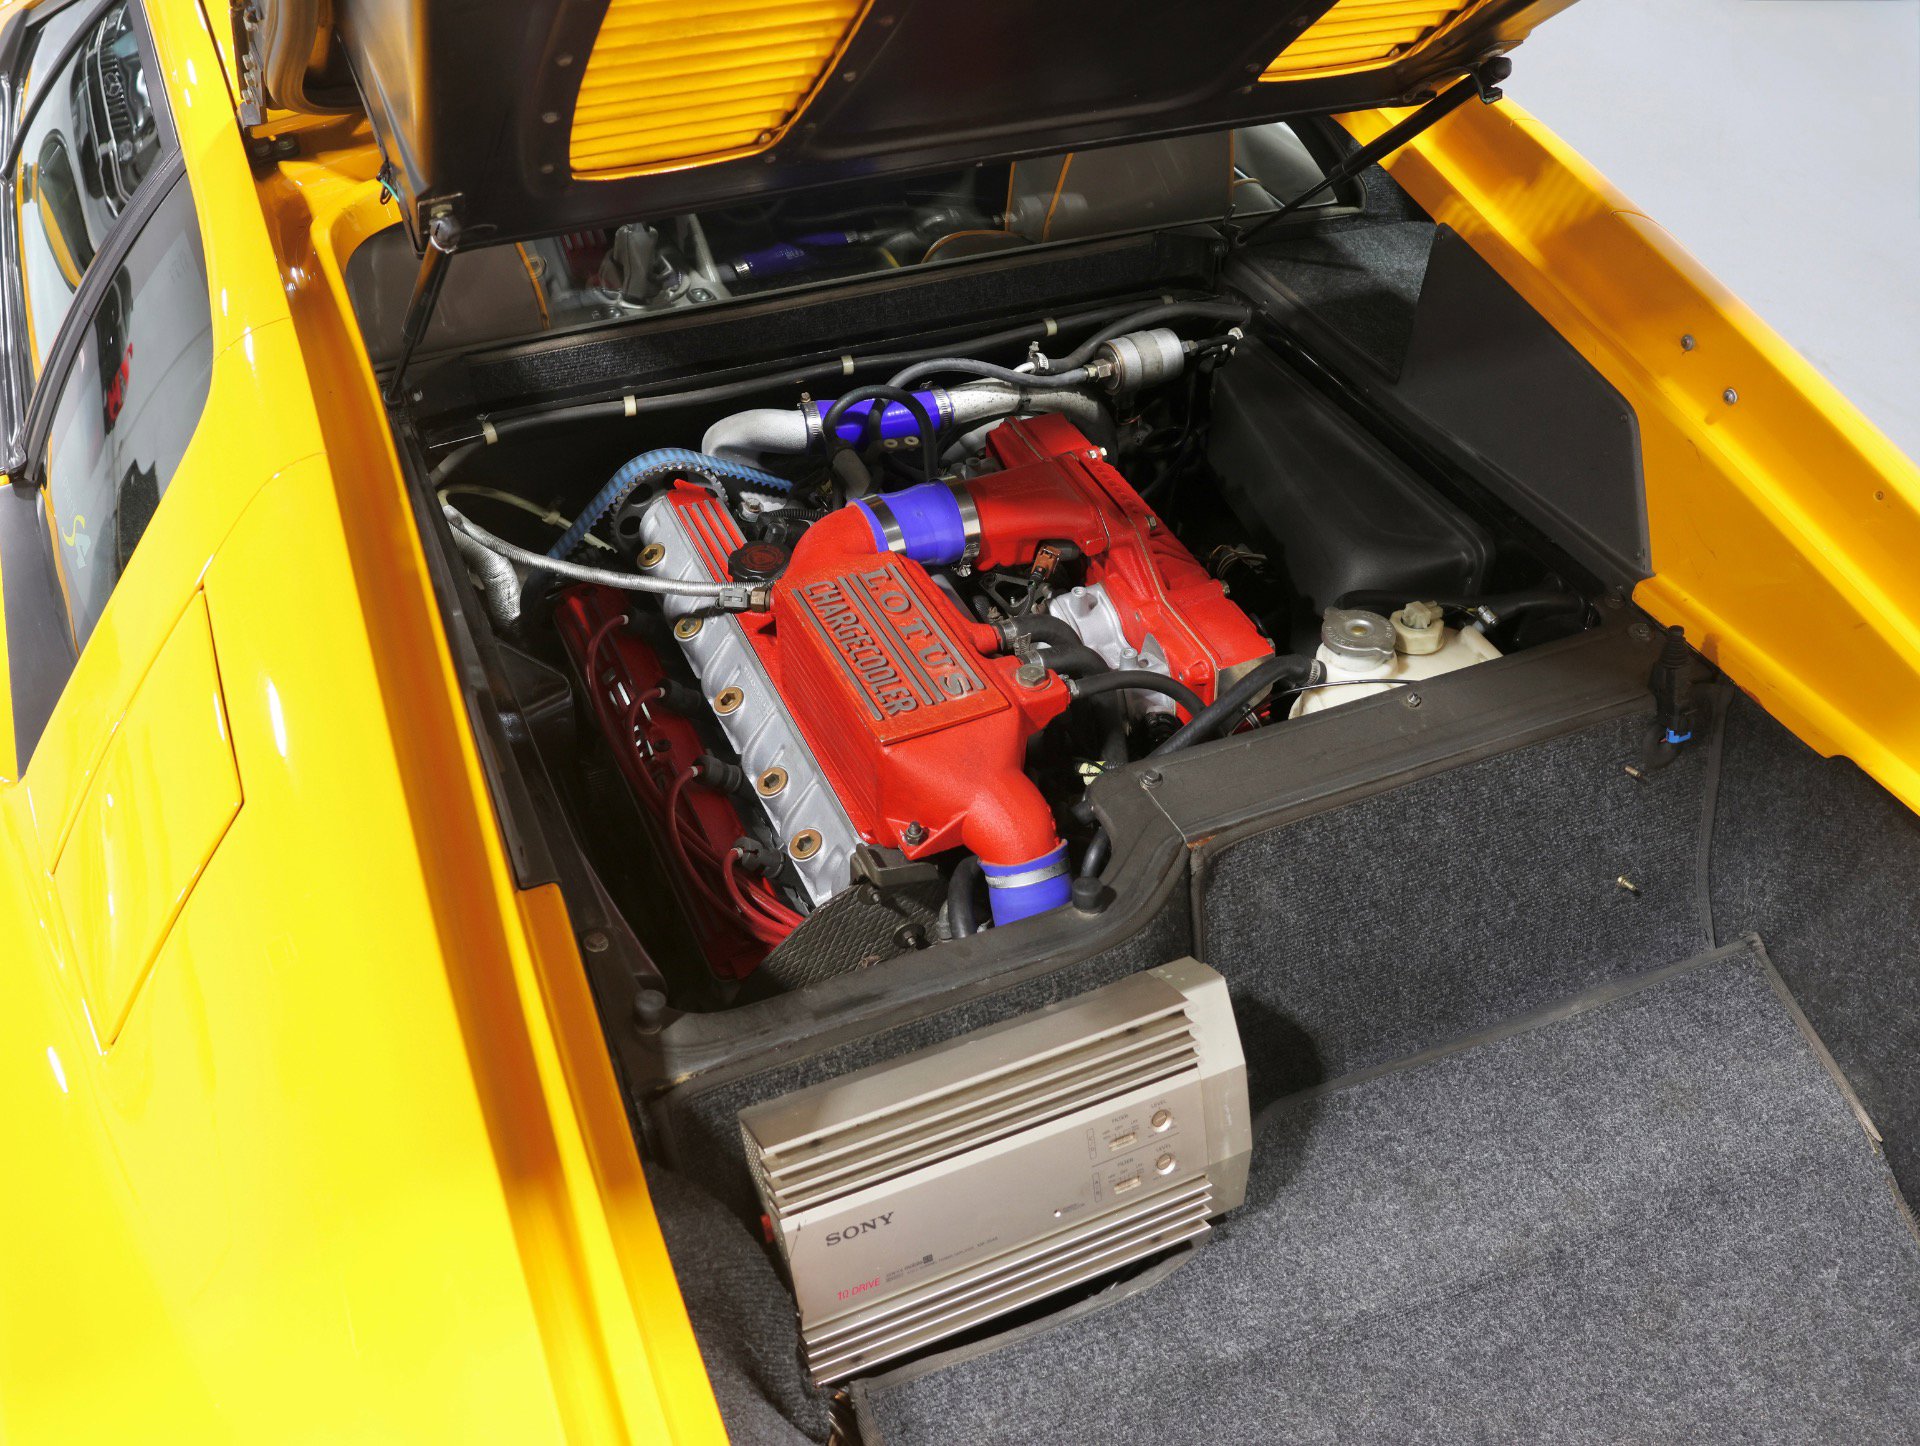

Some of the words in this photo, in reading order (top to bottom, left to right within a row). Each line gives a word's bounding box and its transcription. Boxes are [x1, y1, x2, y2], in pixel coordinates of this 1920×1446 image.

[804, 580, 917, 716] CHARGECOOLER
[859, 567, 972, 700] LOTUS
[825, 1211, 895, 1247] SONY
[852, 1277, 881, 1296] DRIVE
